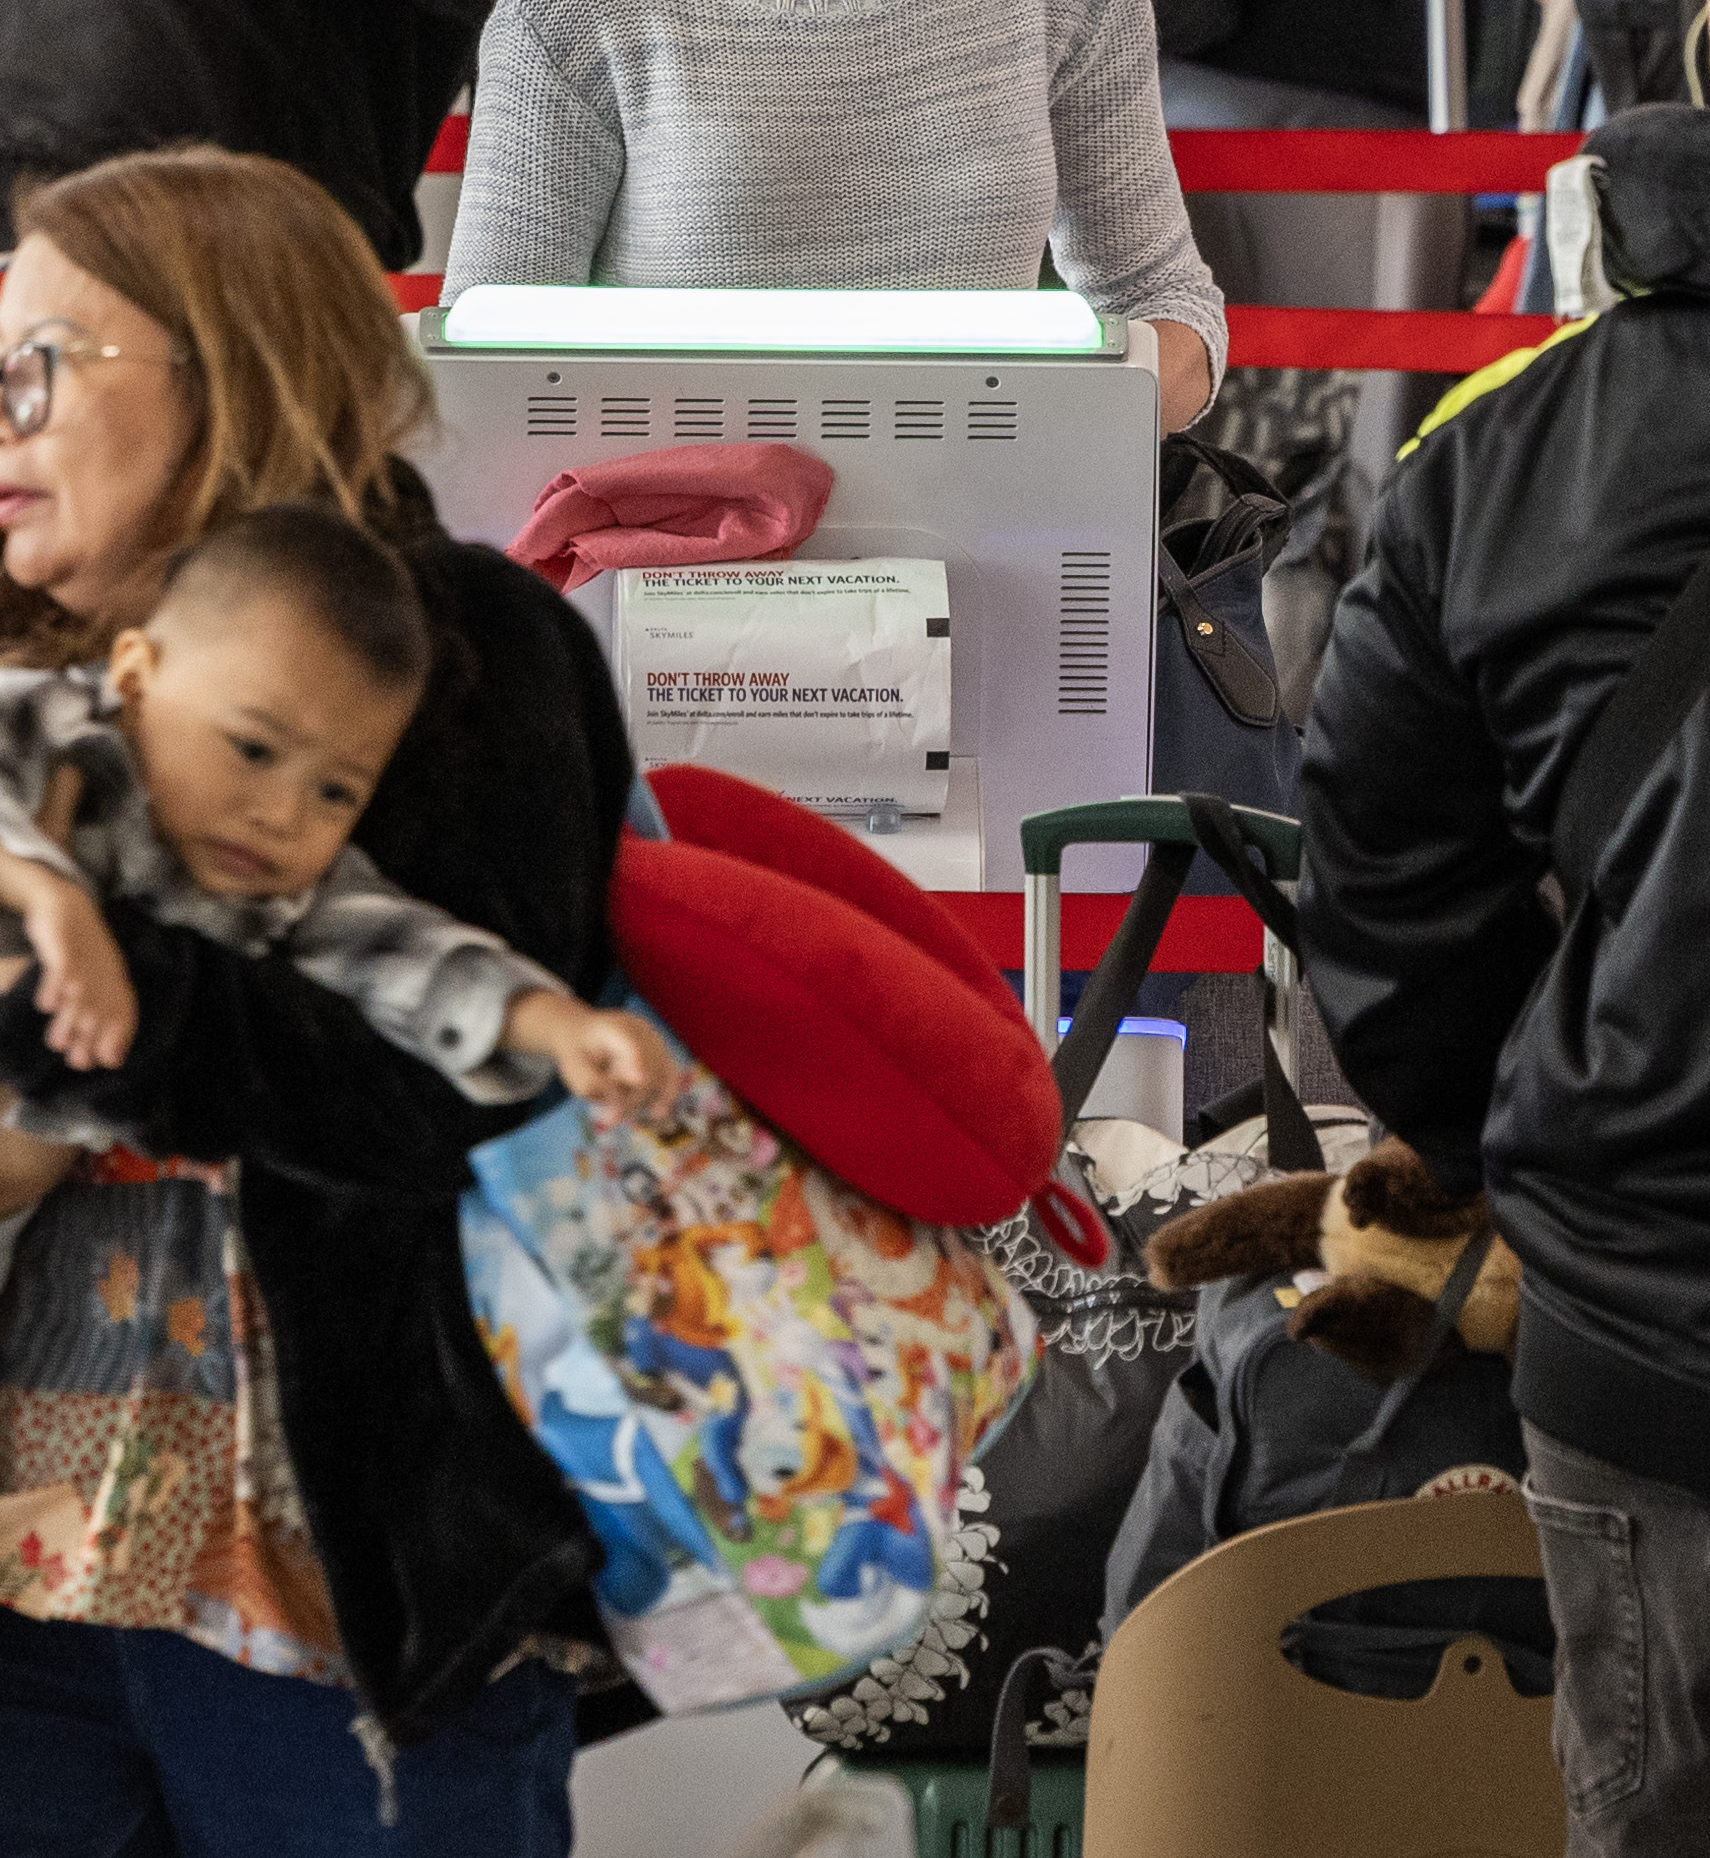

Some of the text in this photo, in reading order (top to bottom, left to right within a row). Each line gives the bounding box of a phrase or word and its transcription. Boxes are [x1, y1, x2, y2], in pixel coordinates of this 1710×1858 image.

[642, 570, 785, 579] DON'T THROW AWAY
[644, 575, 900, 587] THE TICKET TO YOUR NEXT VACATION.
[647, 673, 789, 686] DON'T THROW AWAY
[647, 688, 904, 702] THE TICKET TO YOUR NEXT VACATION.
